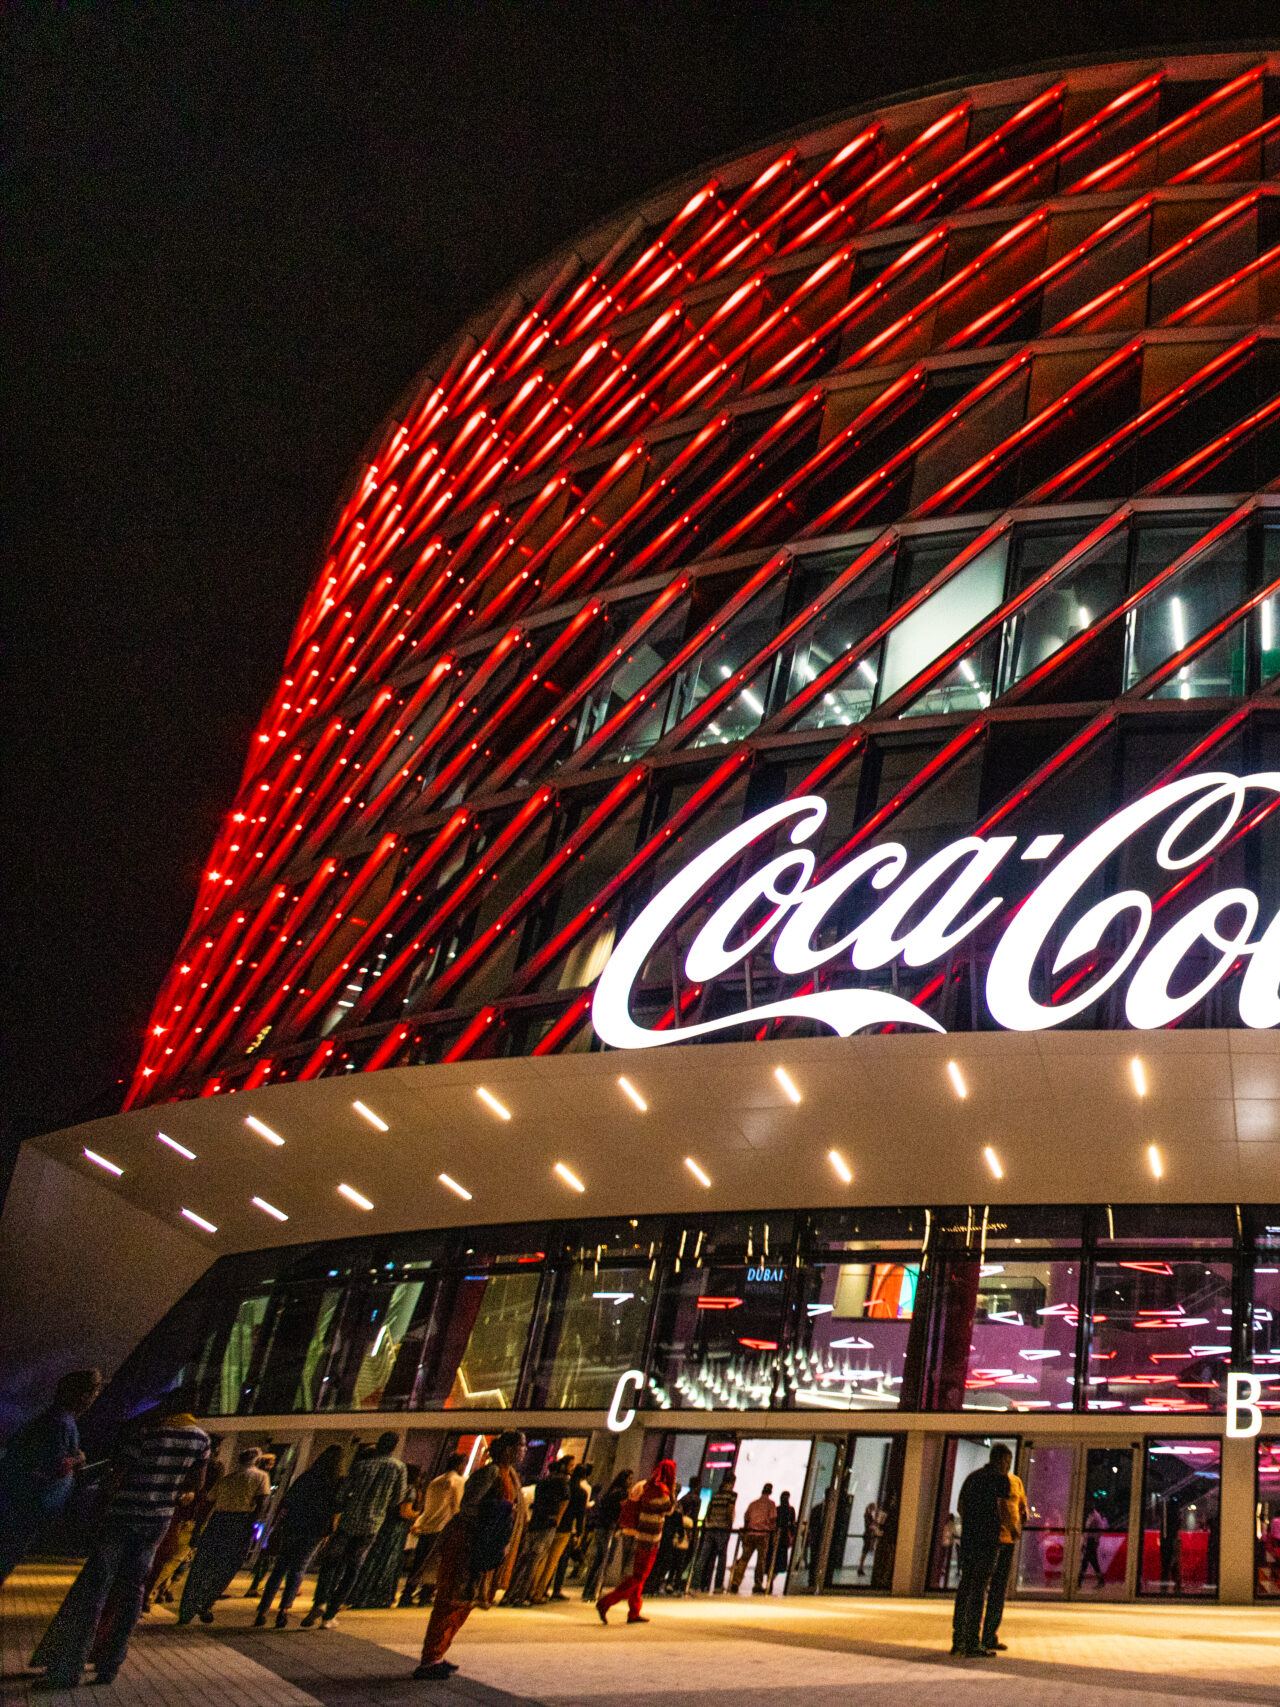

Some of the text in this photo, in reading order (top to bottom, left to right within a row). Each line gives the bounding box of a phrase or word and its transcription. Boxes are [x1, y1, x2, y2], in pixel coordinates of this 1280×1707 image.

[747, 1268, 784, 1281] DUBAI
[607, 1369, 644, 1432] C
[1226, 1372, 1263, 1438] B
